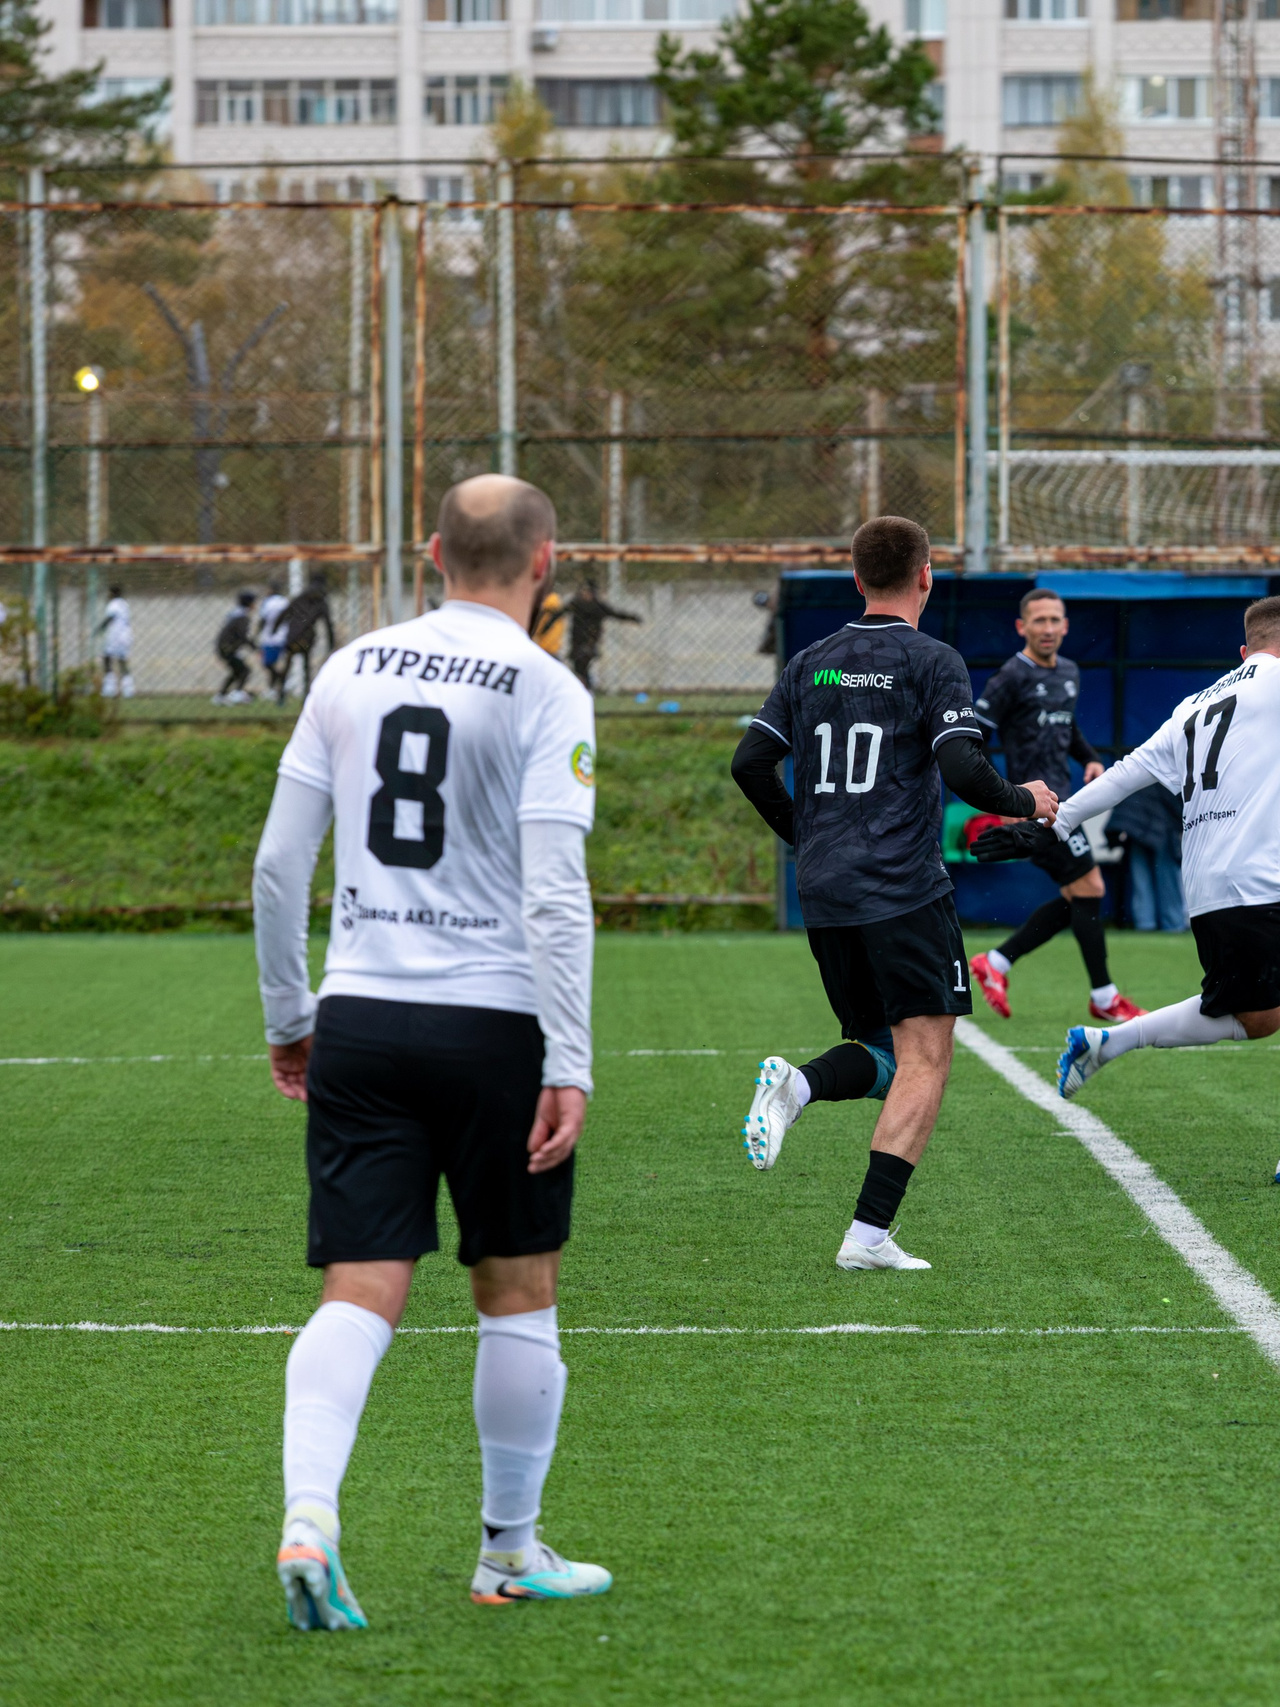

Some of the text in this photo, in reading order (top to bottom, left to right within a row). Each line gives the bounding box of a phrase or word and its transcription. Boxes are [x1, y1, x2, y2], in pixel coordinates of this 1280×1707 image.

[354, 647, 520, 696] ТУРБИНА
[813, 722, 884, 795] 10
[1182, 694, 1237, 804] 17
[366, 703, 451, 871] 8
[1209, 810, 1237, 821] Гарант
[439, 910, 499, 931] Гарант
[953, 959, 971, 992] 1
